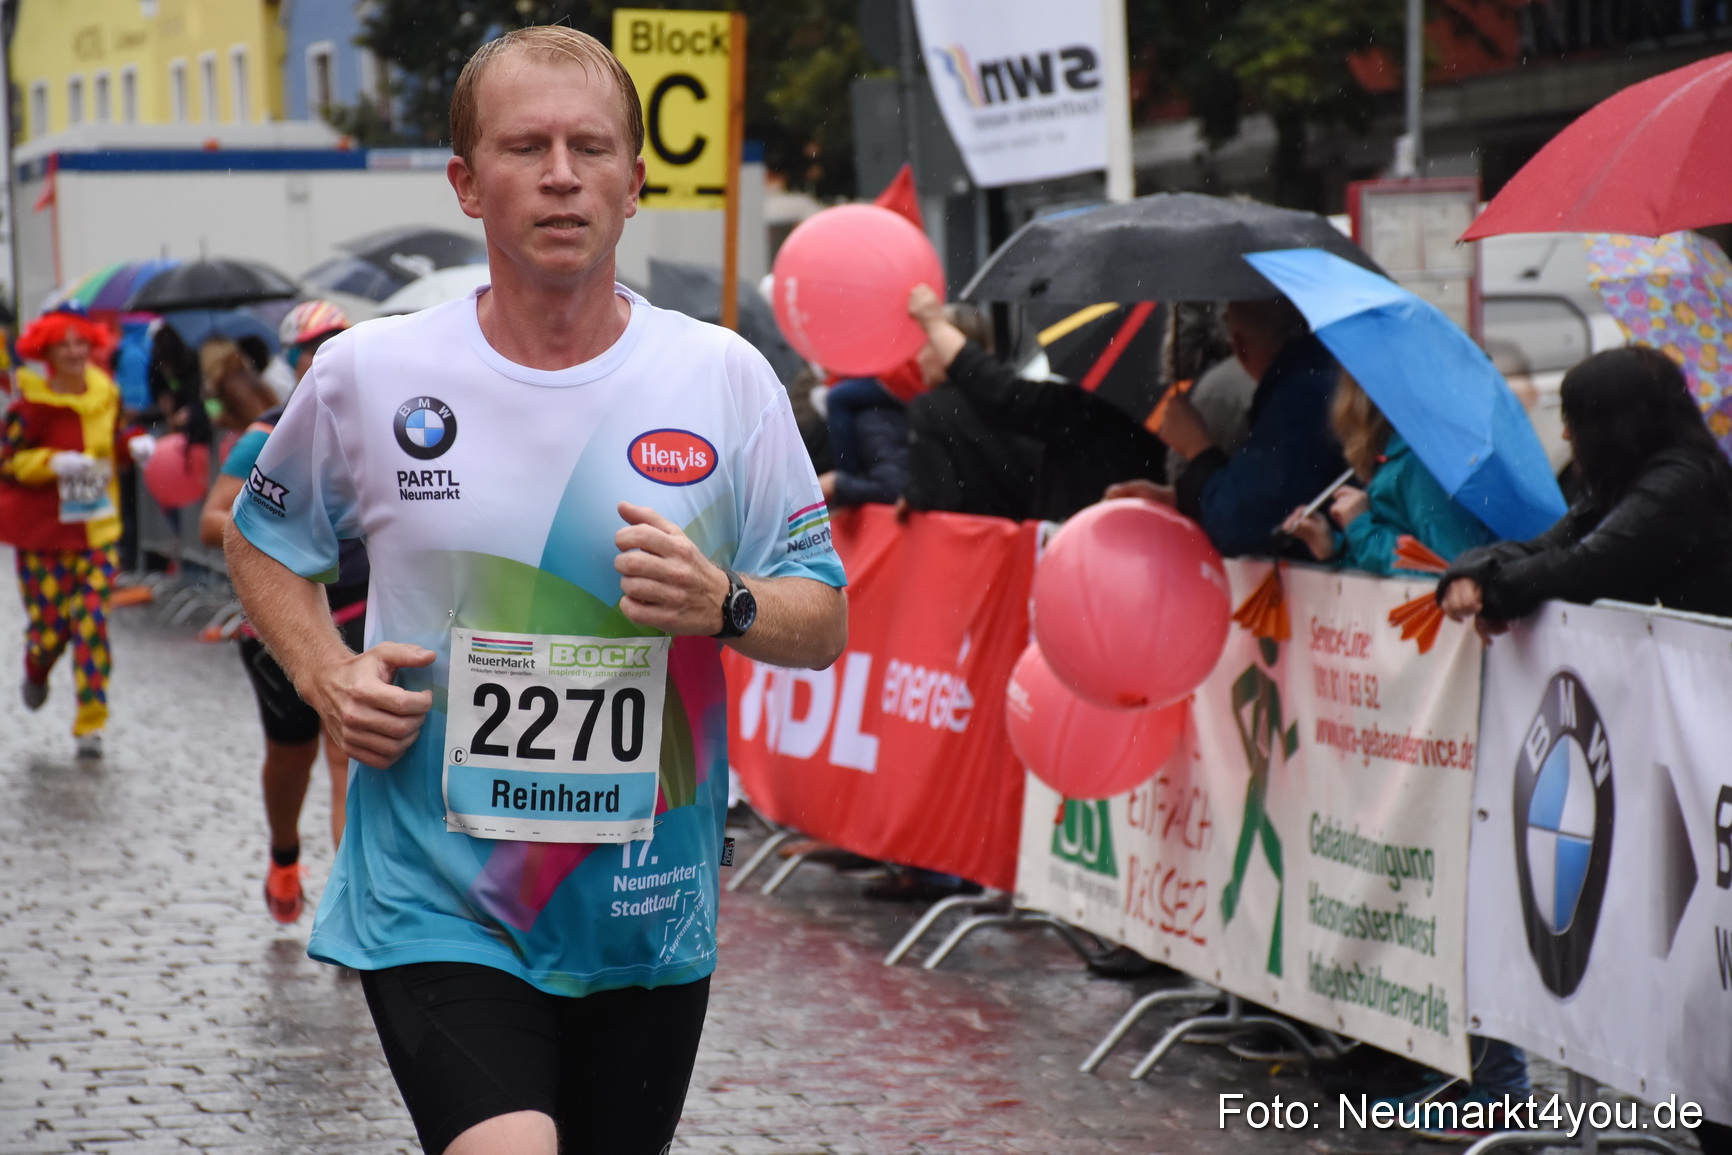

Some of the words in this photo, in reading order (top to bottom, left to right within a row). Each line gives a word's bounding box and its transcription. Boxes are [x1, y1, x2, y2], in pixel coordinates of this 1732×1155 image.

[631, 20, 729, 54] Block
[648, 73, 707, 166] C
[398, 397, 452, 419] BMW
[641, 442, 707, 471] Hervis
[249, 464, 288, 510] CK
[397, 470, 460, 487] PARTL
[253, 496, 285, 518] concepts
[399, 488, 460, 501] Neumarkt
[468, 653, 536, 669] NeuerMarkt
[549, 643, 652, 668] BOCK
[548, 668, 580, 677] inspired
[582, 669, 592, 677] by
[619, 670, 651, 678] concepts
[470, 682, 645, 762] 2270
[1525, 678, 1611, 789] BMW
[454, 749, 463, 763] C
[491, 779, 620, 813] Reinhard
[617, 840, 659, 869] 17.
[613, 865, 697, 892] Neumarkter
[611, 889, 681, 917] Stadtlauf
[669, 911, 695, 954] September
